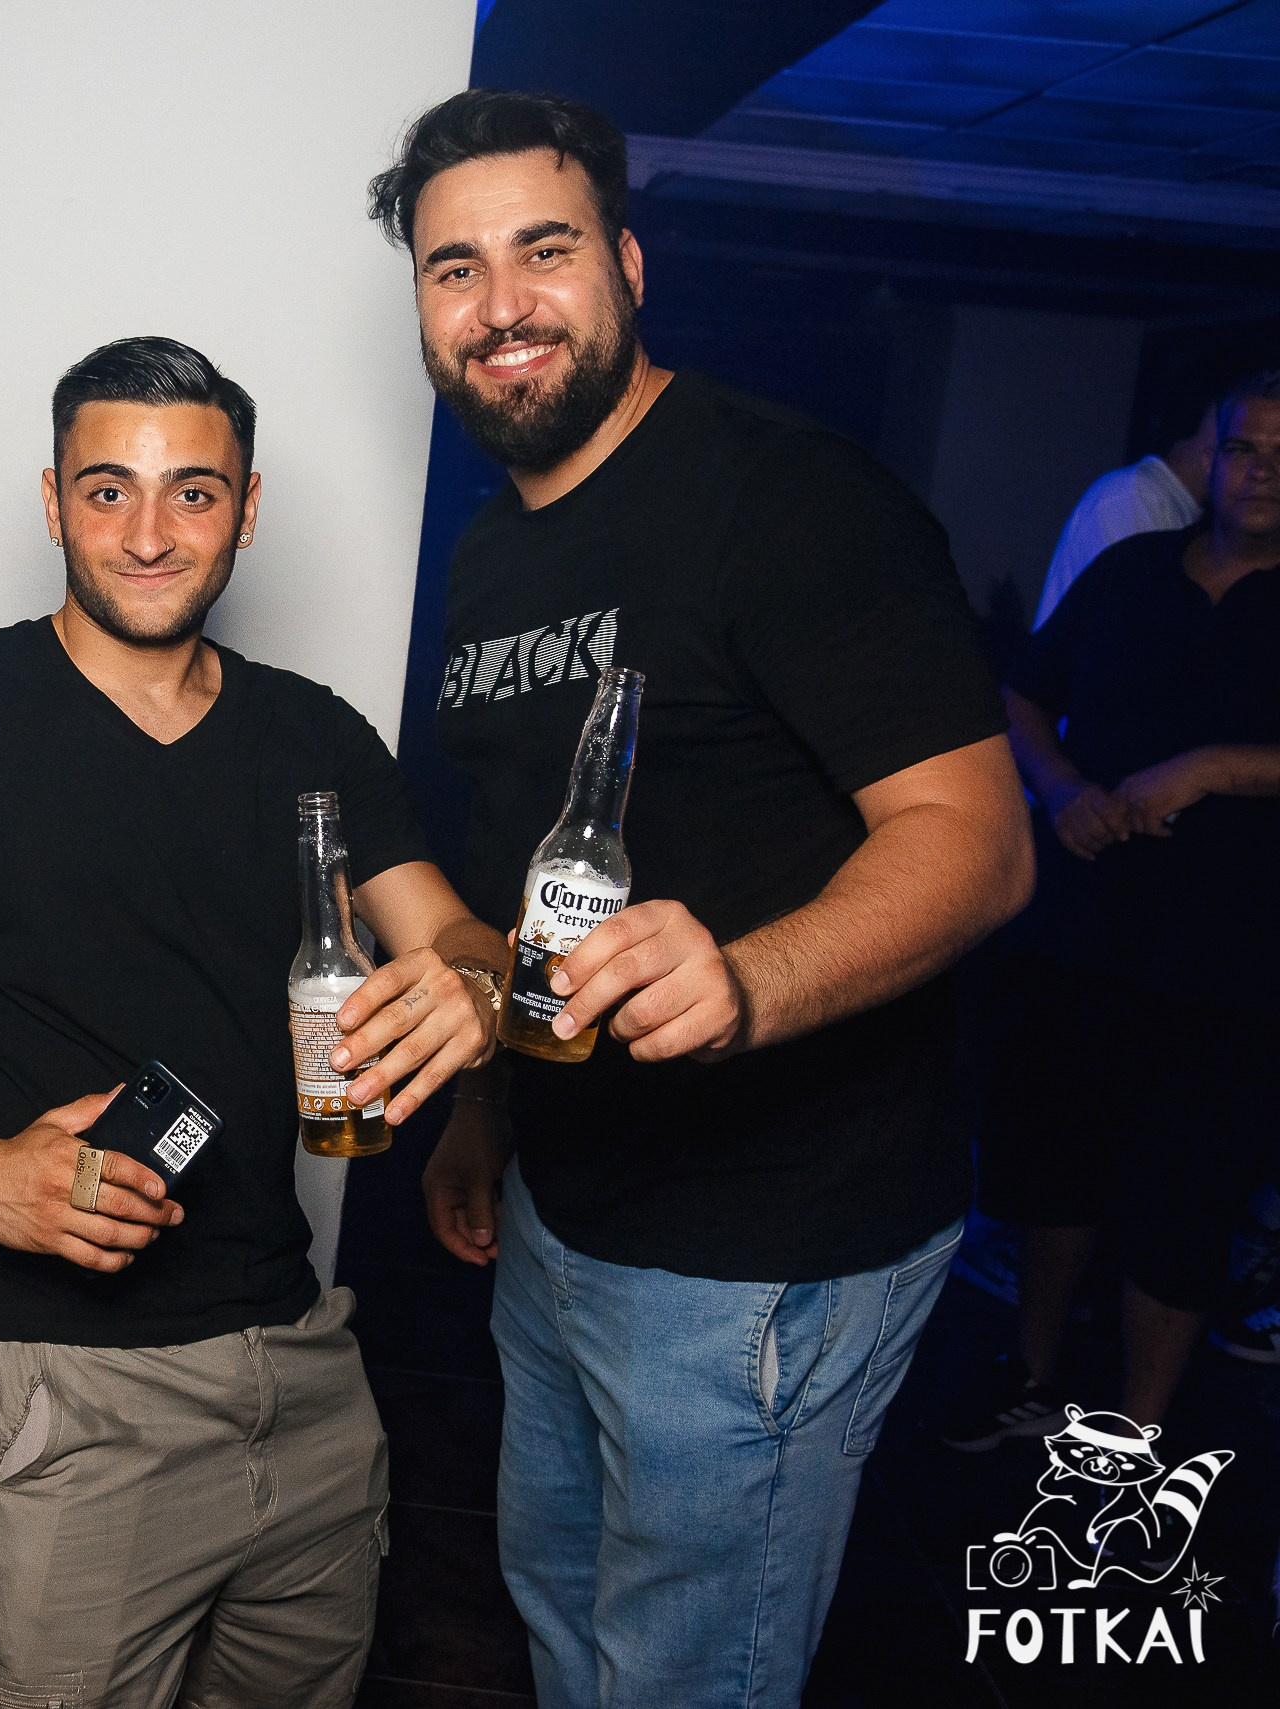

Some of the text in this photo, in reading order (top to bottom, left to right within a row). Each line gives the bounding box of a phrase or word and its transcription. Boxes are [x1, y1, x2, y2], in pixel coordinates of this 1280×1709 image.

[437, 607, 620, 711] BLACK
[540, 880, 623, 915] Corona
[557, 912, 602, 930] cerve
[512, 992, 562, 1013] CERVECERIA MODEL
